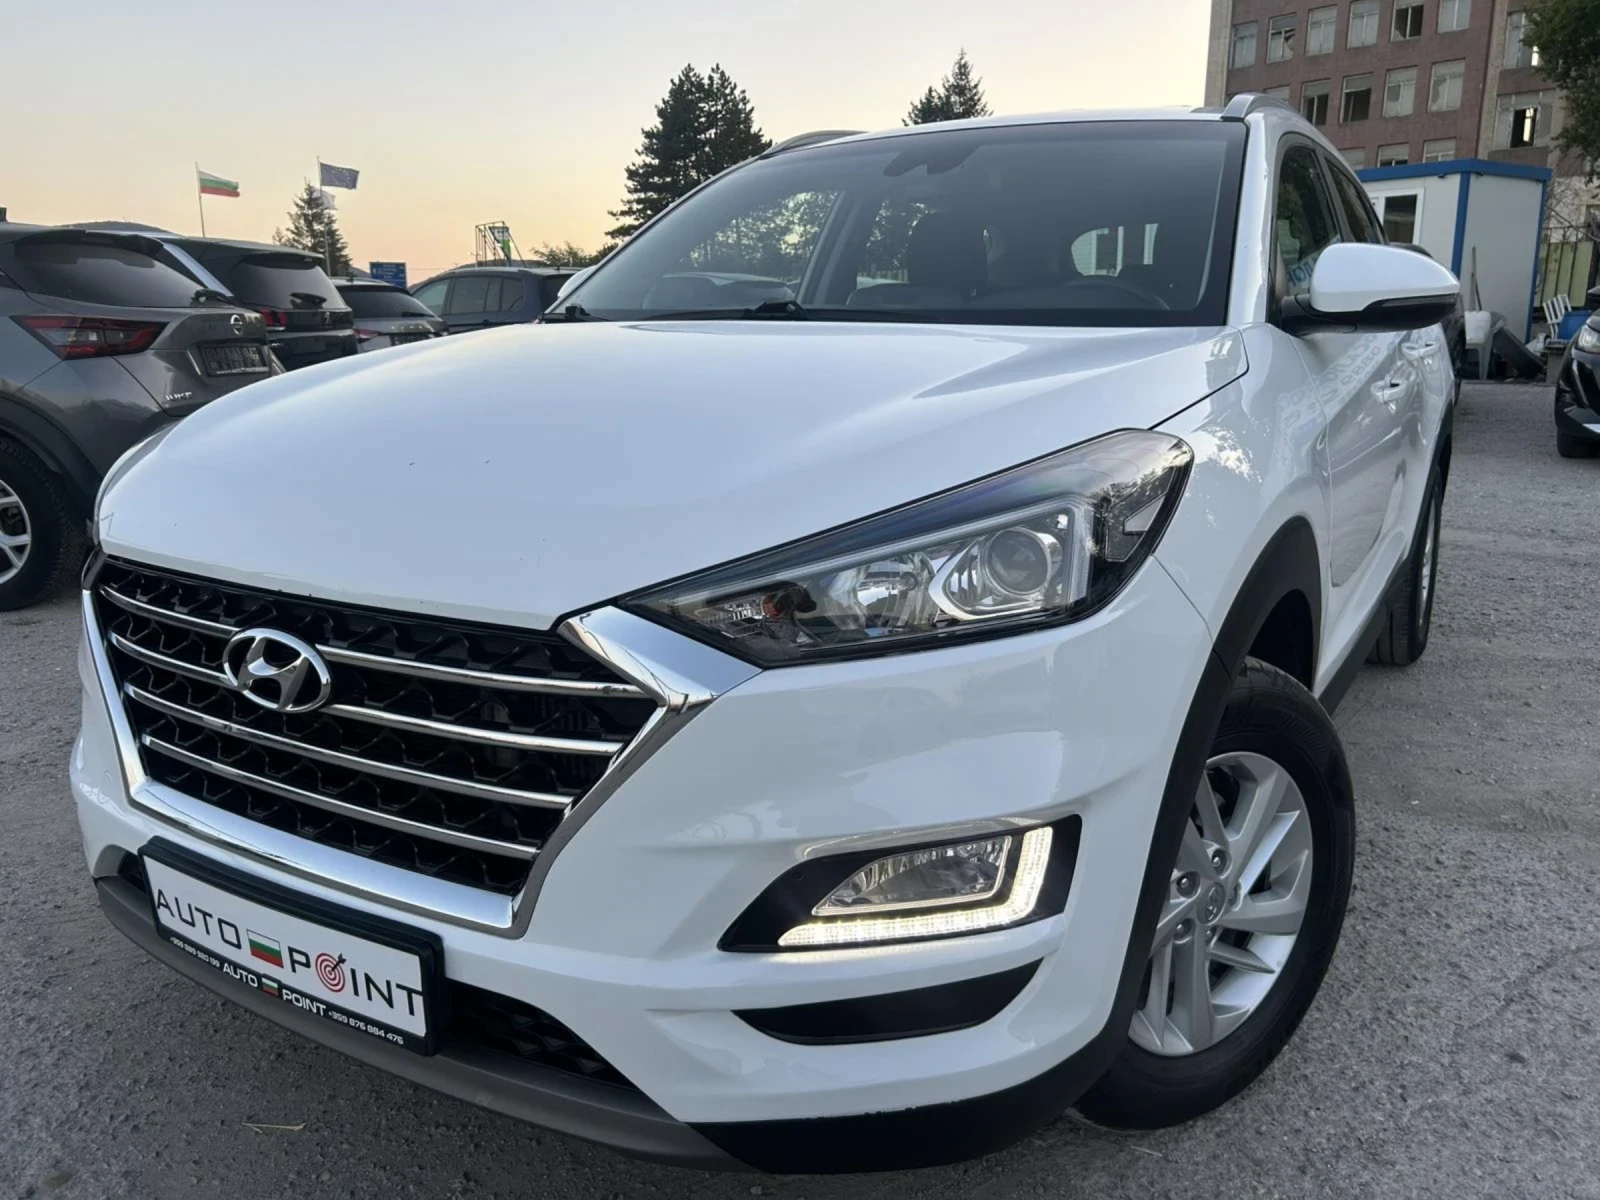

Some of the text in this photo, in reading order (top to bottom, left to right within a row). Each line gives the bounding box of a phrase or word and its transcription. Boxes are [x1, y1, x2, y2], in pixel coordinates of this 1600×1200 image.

[156, 888, 242, 950] AUTO
[222, 962, 258, 988] AUTO
[282, 989, 326, 1017] POINT
[386, 1032, 404, 1045] 476
